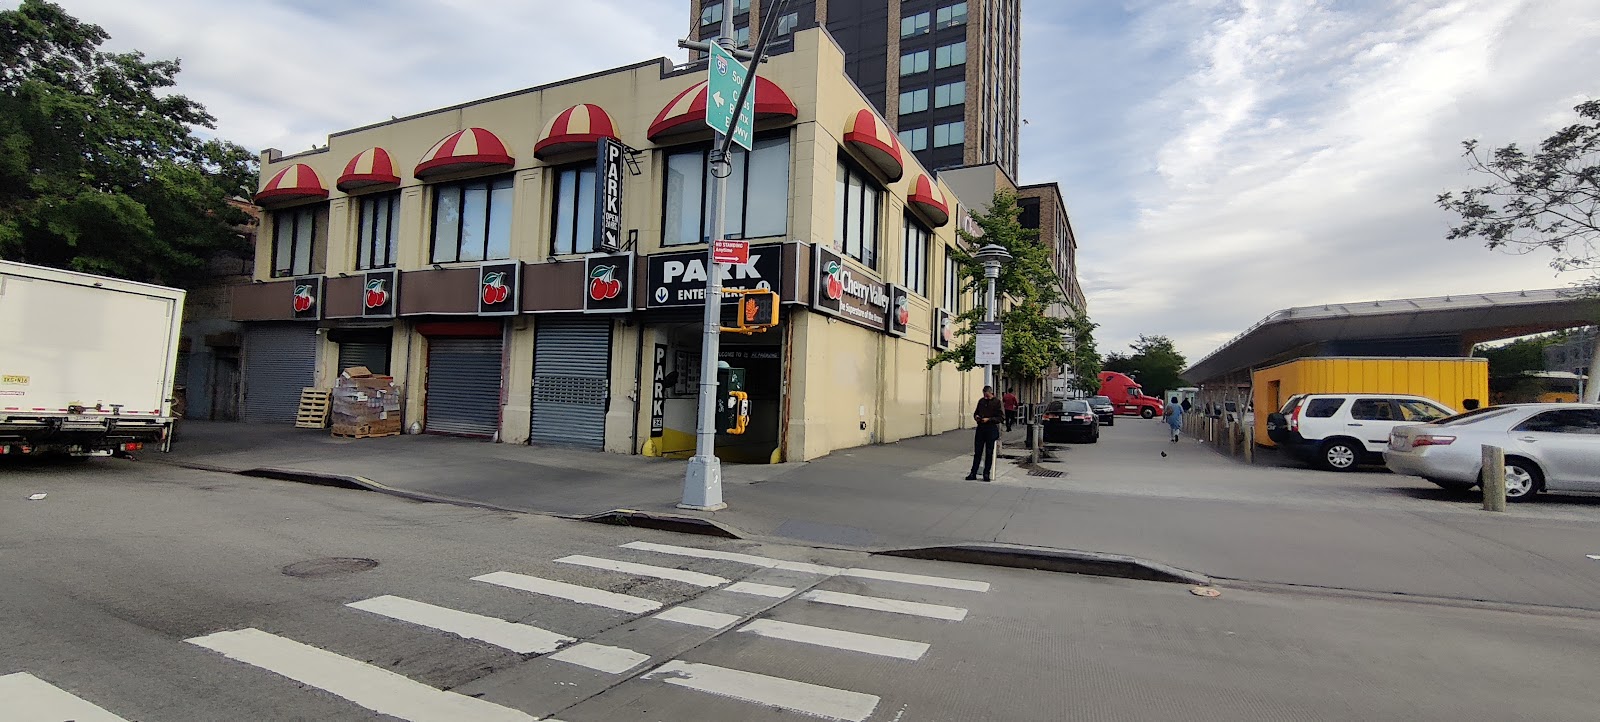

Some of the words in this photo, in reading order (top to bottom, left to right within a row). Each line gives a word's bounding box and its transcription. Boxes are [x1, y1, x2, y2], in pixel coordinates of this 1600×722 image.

[717, 59, 727, 74] 95
[729, 102, 749, 126] Bnx
[725, 115, 748, 141] Epwy
[607, 144, 619, 214] PARK
[605, 212, 619, 223] OPEN
[677, 288, 707, 300] ENTE
[842, 270, 869, 305] Cherry
[869, 284, 890, 314] Valley
[846, 303, 865, 317] Superstore
[653, 347, 665, 416] PARK
